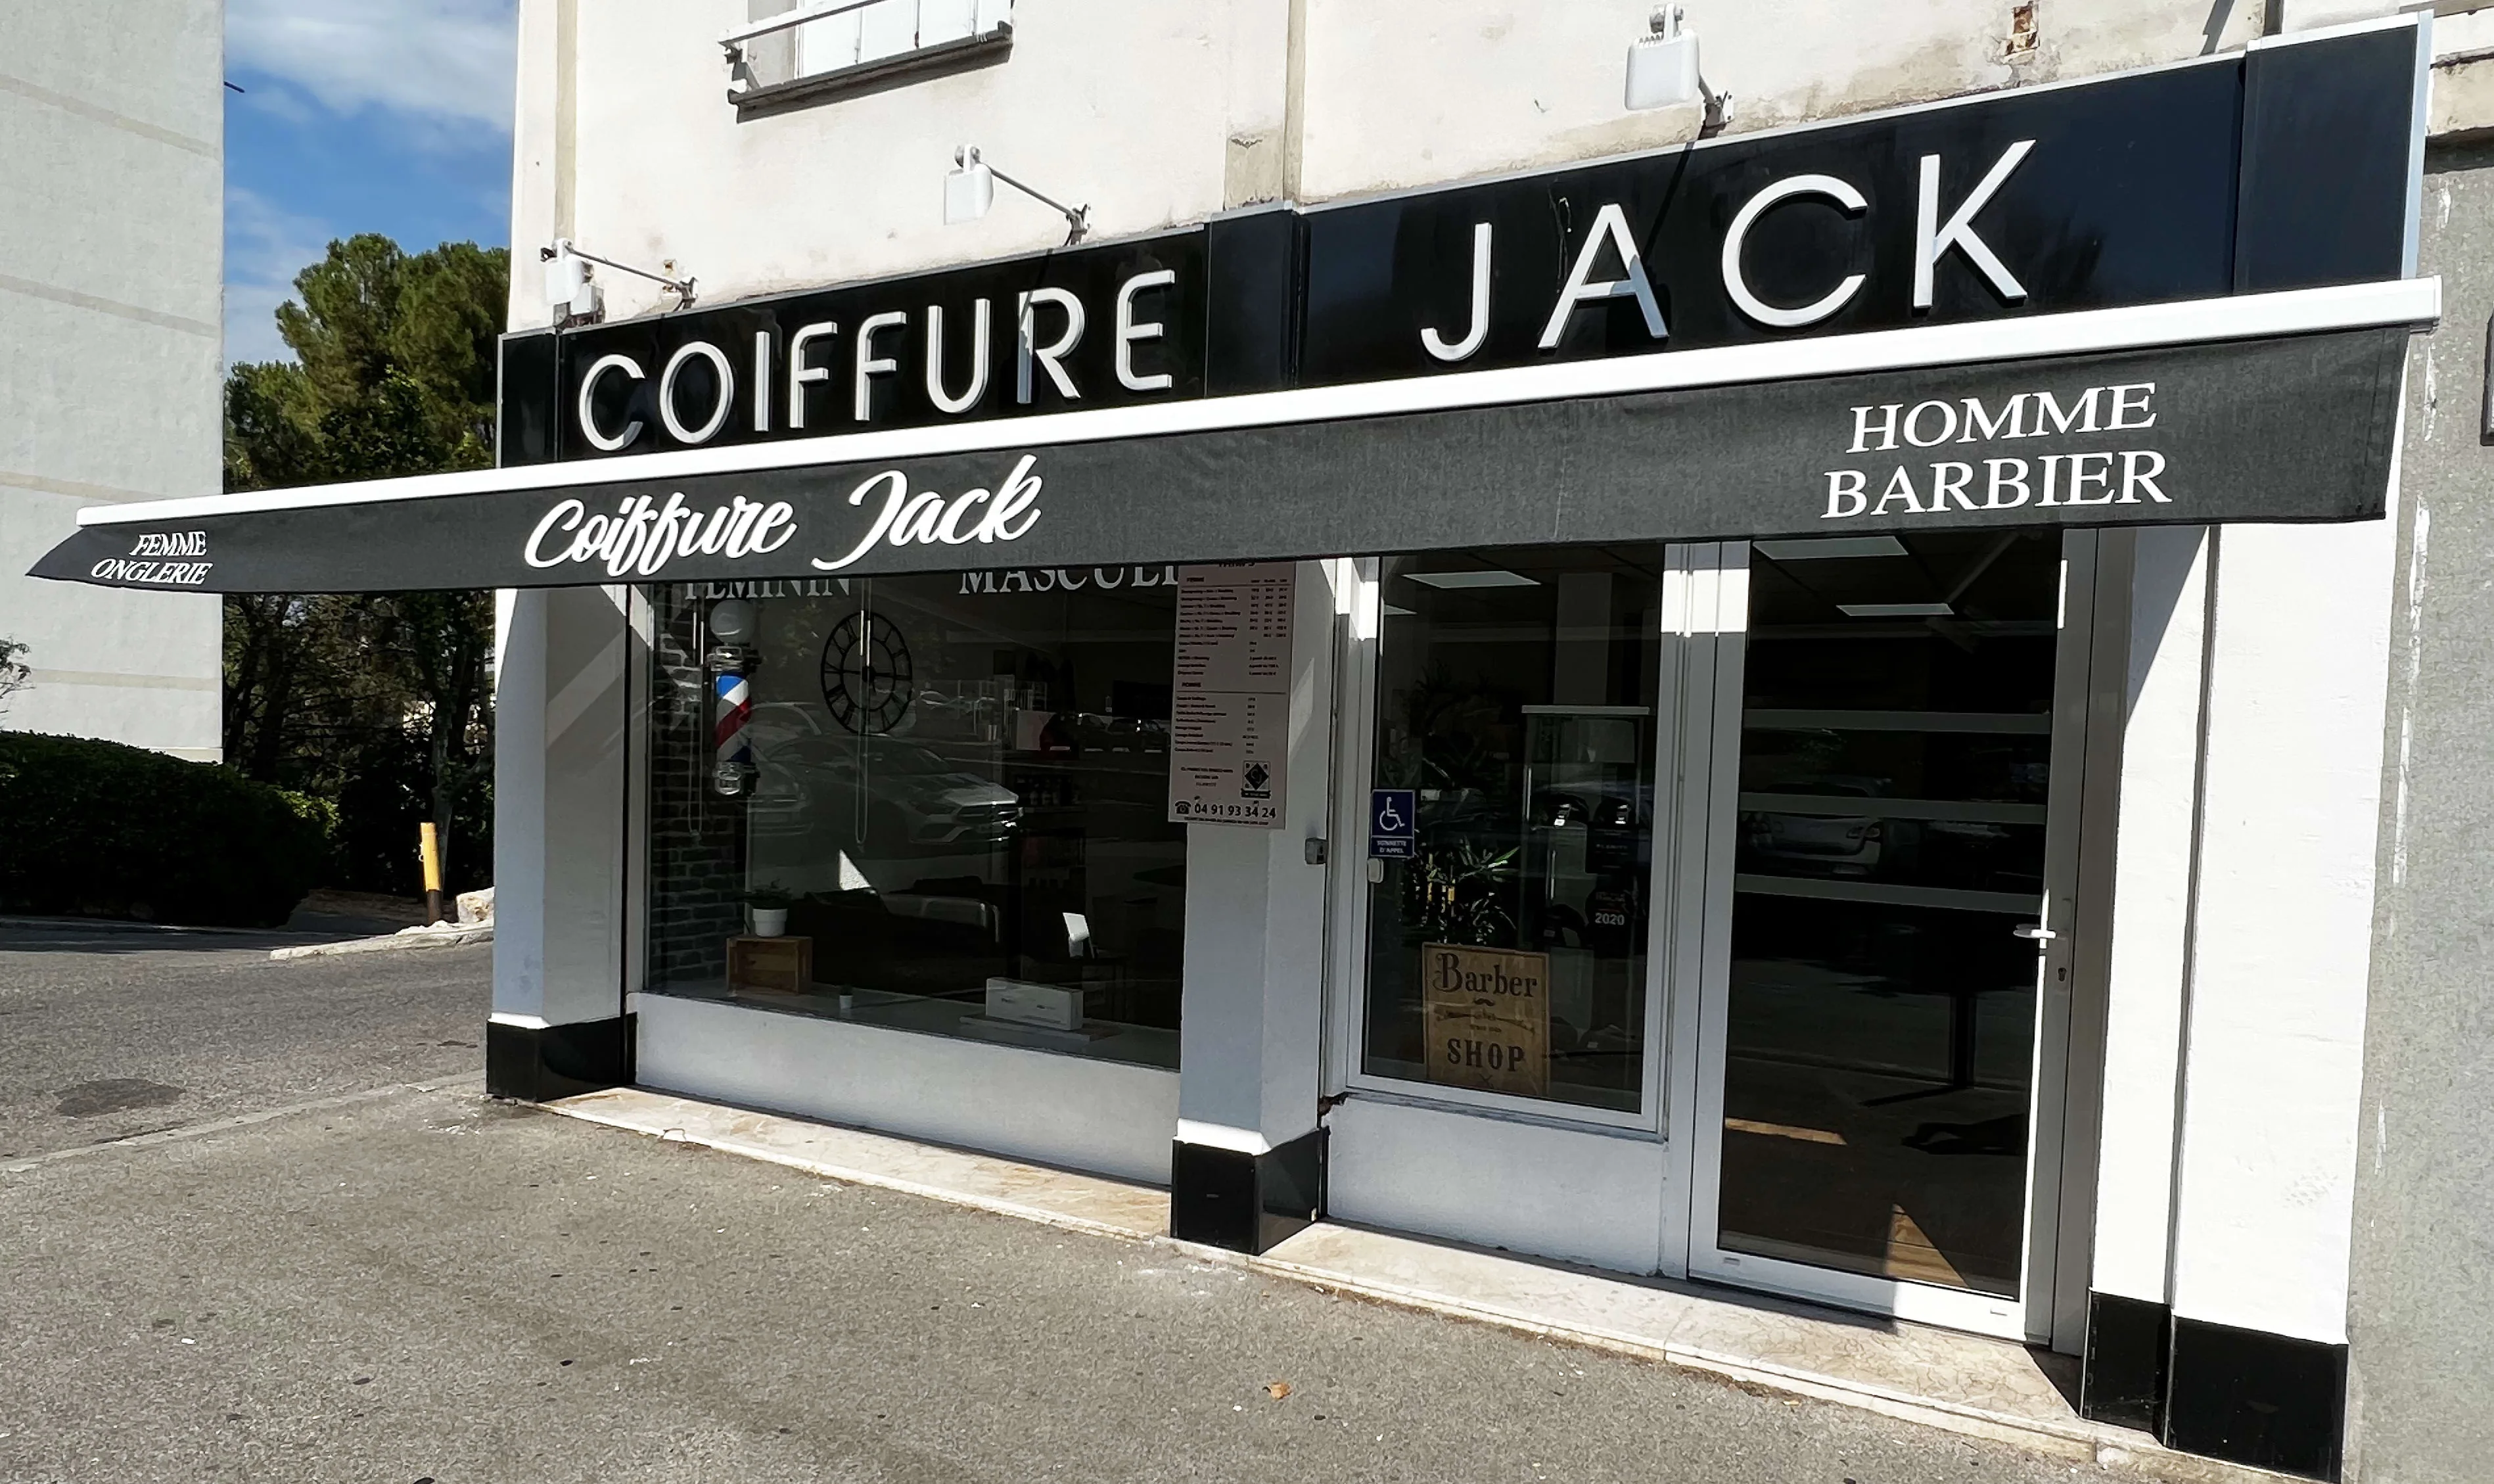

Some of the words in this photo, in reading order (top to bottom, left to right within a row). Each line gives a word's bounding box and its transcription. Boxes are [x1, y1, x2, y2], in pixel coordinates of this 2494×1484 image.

[578, 269, 1176, 452] COIFFURE
[1421, 139, 2036, 362] JACK
[1845, 383, 2159, 455] HOMME
[1820, 450, 2173, 520] BARBIER
[524, 492, 798, 578] Coiffure
[812, 455, 1044, 571] Jack
[129, 530, 207, 556] FEMME
[90, 559, 214, 585] ONGLERIE
[1194, 803, 1207, 814] 04
[1211, 804, 1223, 815] 91
[1228, 805, 1241, 816] 93
[1245, 806, 1259, 818] 34
[1261, 807, 1276, 818] 24
[1595, 912, 1625, 925] 2020
[1432, 953, 1537, 998] Barber
[1446, 1038, 1525, 1072] SHOP
